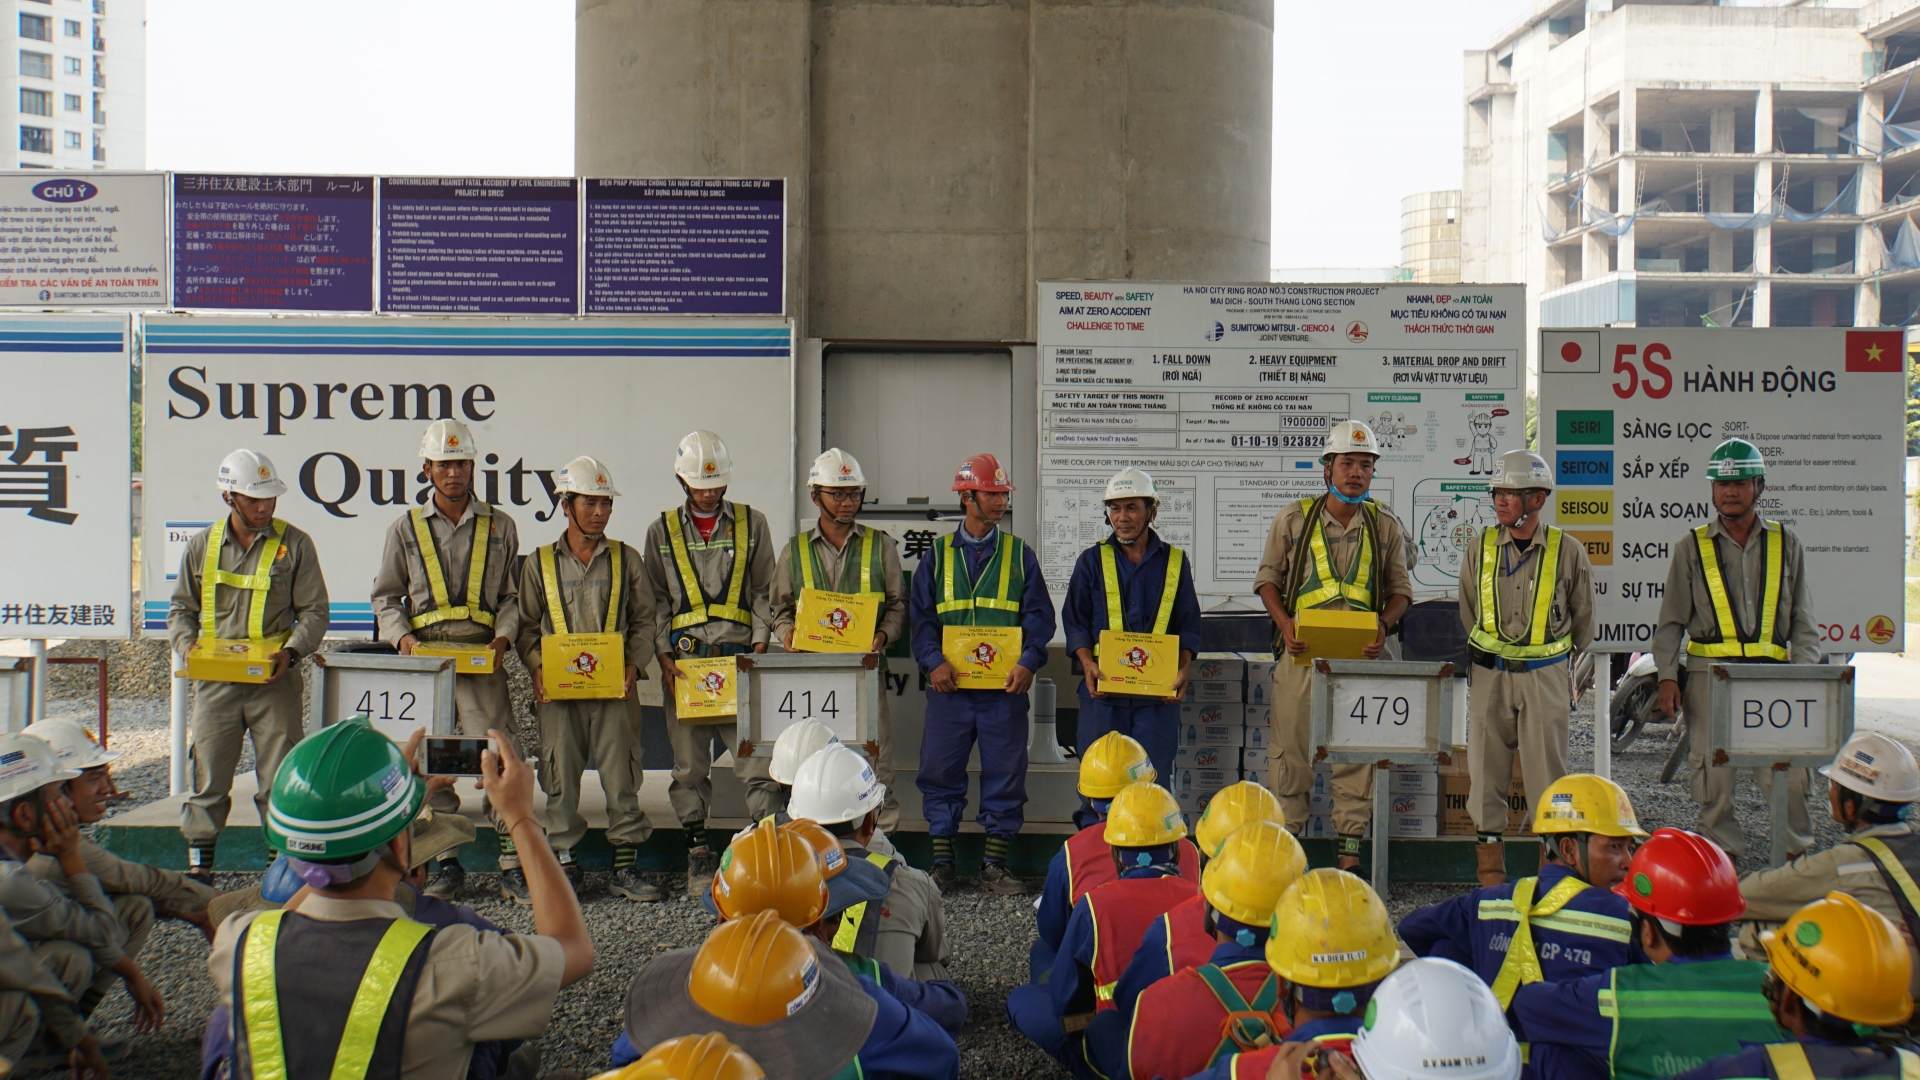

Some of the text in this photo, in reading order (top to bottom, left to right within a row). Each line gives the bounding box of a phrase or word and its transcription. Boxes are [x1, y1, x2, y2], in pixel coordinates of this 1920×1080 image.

[183, 177, 364, 192] 三井住友建設土木部門 ルール
[483, 179, 509, 187] ACCIDENT
[511, 179, 517, 187] OF
[43, 185, 86, 198] CHÚ Ý
[455, 189, 479, 197] PROJECT
[481, 189, 486, 197] IN
[1056, 292, 1154, 301] SPEED, BEAUTY SAFETY
[1461, 295, 1471, 304] AN
[1059, 307, 1073, 315] AIM
[1075, 307, 1085, 315] AT
[1087, 307, 1109, 315] ZERO
[1391, 309, 1506, 320] MỤC TIÊU KHÔNG CÓ TAI NẠN
[1067, 322, 1144, 330] CHALLENGE TO TIME
[1231, 324, 1270, 332] SUMITOMO
[1272, 324, 1295, 332] MITSUI
[1301, 324, 1328, 332] CIENCO
[1153, 355, 1210, 364] 1. FALL DOWN
[1249, 356, 1337, 365] 2. HEAVY EQUIPMENT
[1382, 356, 1506, 366] 3. MATERIAL DROP AND DRIFT
[1612, 343, 1836, 399] 5S HÀNH ĐỘNG
[168, 365, 496, 435] Supreme
[1283, 417, 1325, 427] 1900000
[1570, 421, 1600, 434] SEIRI
[1722, 422, 1749, 431] -SORT-
[1623, 418, 1712, 442] SÀNG LỌC
[1231, 436, 1278, 447] 01-10-19
[1283, 436, 1325, 447] 923824
[1756, 433, 1780, 441] Dispose
[1562, 461, 1608, 474] SEITON
[1623, 455, 1690, 478] SẮP XẾP
[1818, 484, 1844, 492] dormitory
[1562, 502, 1608, 514] SEISOU
[1623, 497, 1708, 522] SỬA SOẠN
[1622, 543, 1668, 562] SẠCH
[1622, 582, 1642, 602] SỰ
[1850, 624, 1861, 641] 4
[356, 690, 416, 720] 412
[778, 690, 839, 719] 414
[1350, 696, 1409, 725] 479
[1744, 699, 1817, 728] BOT
[1541, 943, 1560, 960] CP
[1564, 948, 1591, 965] 479
